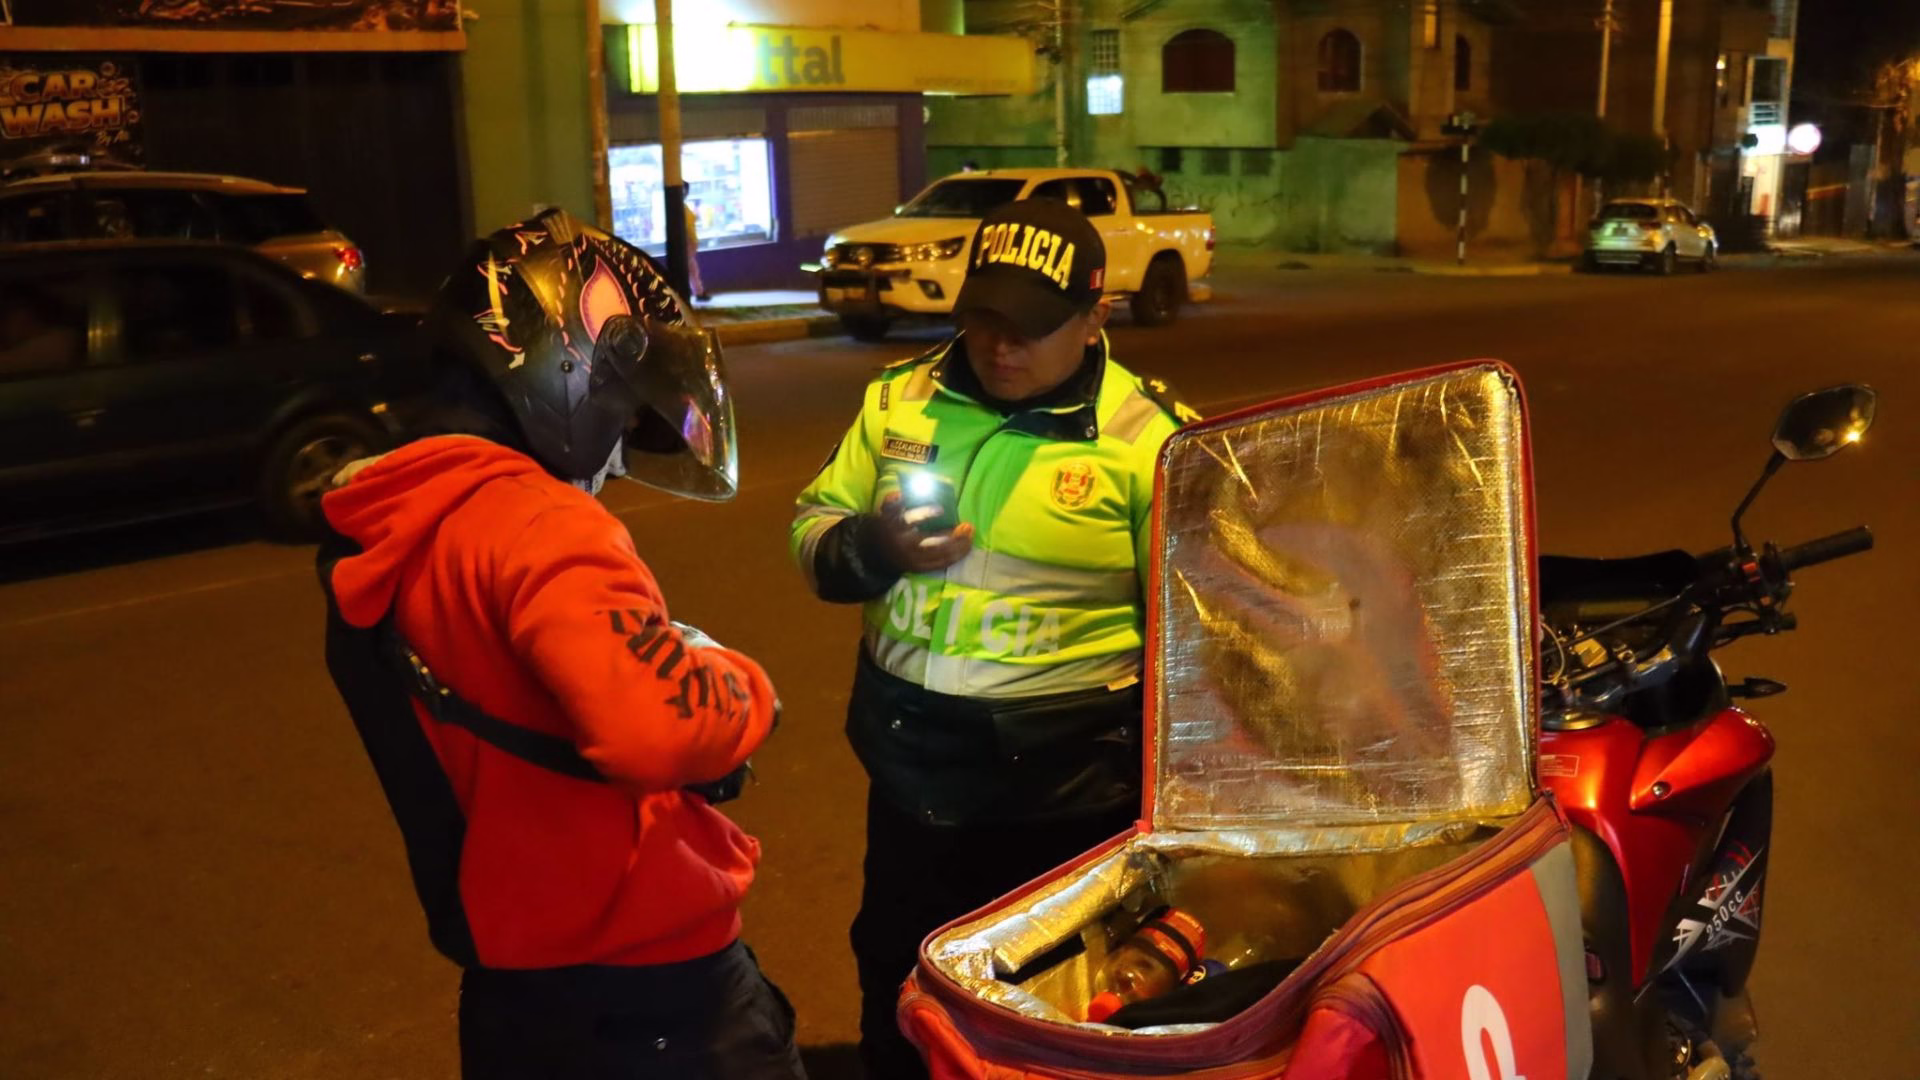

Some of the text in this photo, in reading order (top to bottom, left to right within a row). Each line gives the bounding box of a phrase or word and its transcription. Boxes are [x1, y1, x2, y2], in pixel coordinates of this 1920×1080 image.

[9, 69, 98, 102] CAR
[0, 95, 122, 137] WASH
[976, 223, 1075, 290] POLICIA
[886, 577, 1061, 657] OLICIA
[1706, 890, 1743, 941] 250cc
